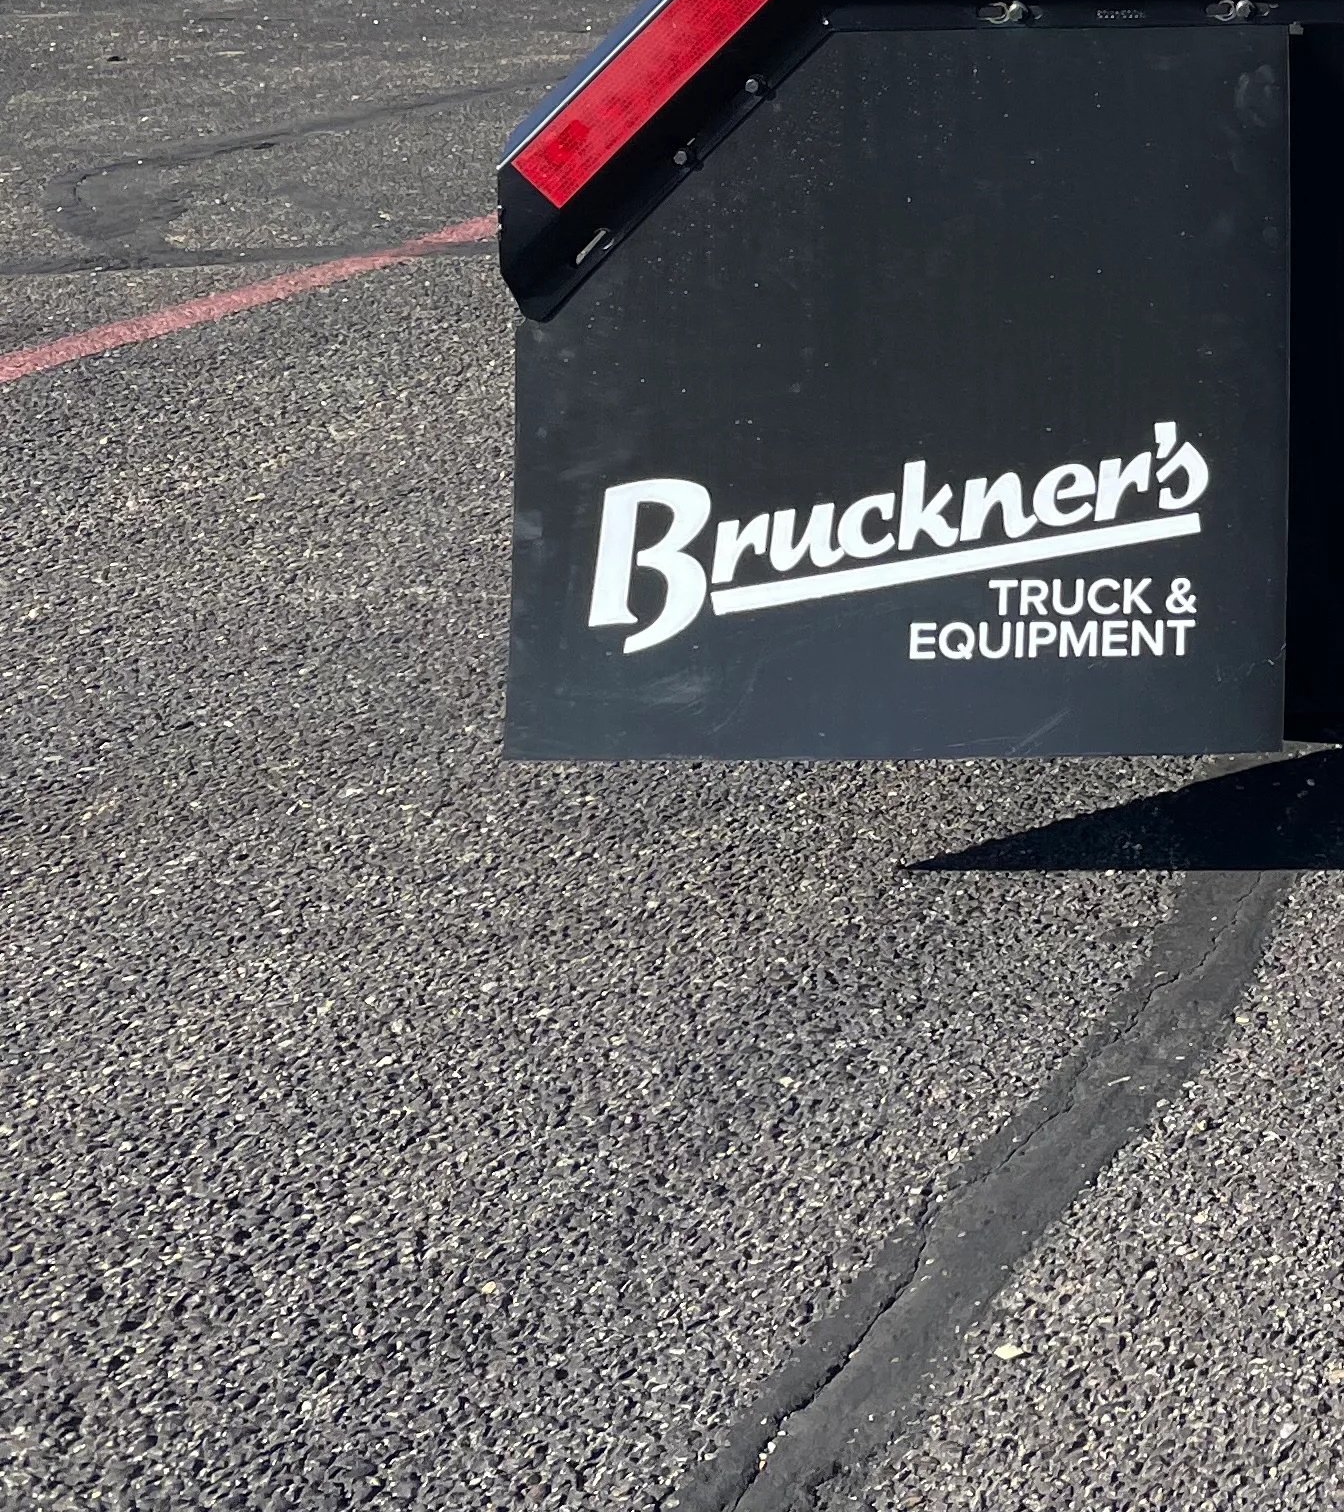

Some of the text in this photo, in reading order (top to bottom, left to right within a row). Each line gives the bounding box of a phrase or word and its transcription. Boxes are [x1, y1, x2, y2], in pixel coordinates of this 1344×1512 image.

[588, 421, 1209, 654] Bruckner's
[989, 578, 1197, 616] TRUCK &
[908, 620, 1196, 660] EQUIPMENT
